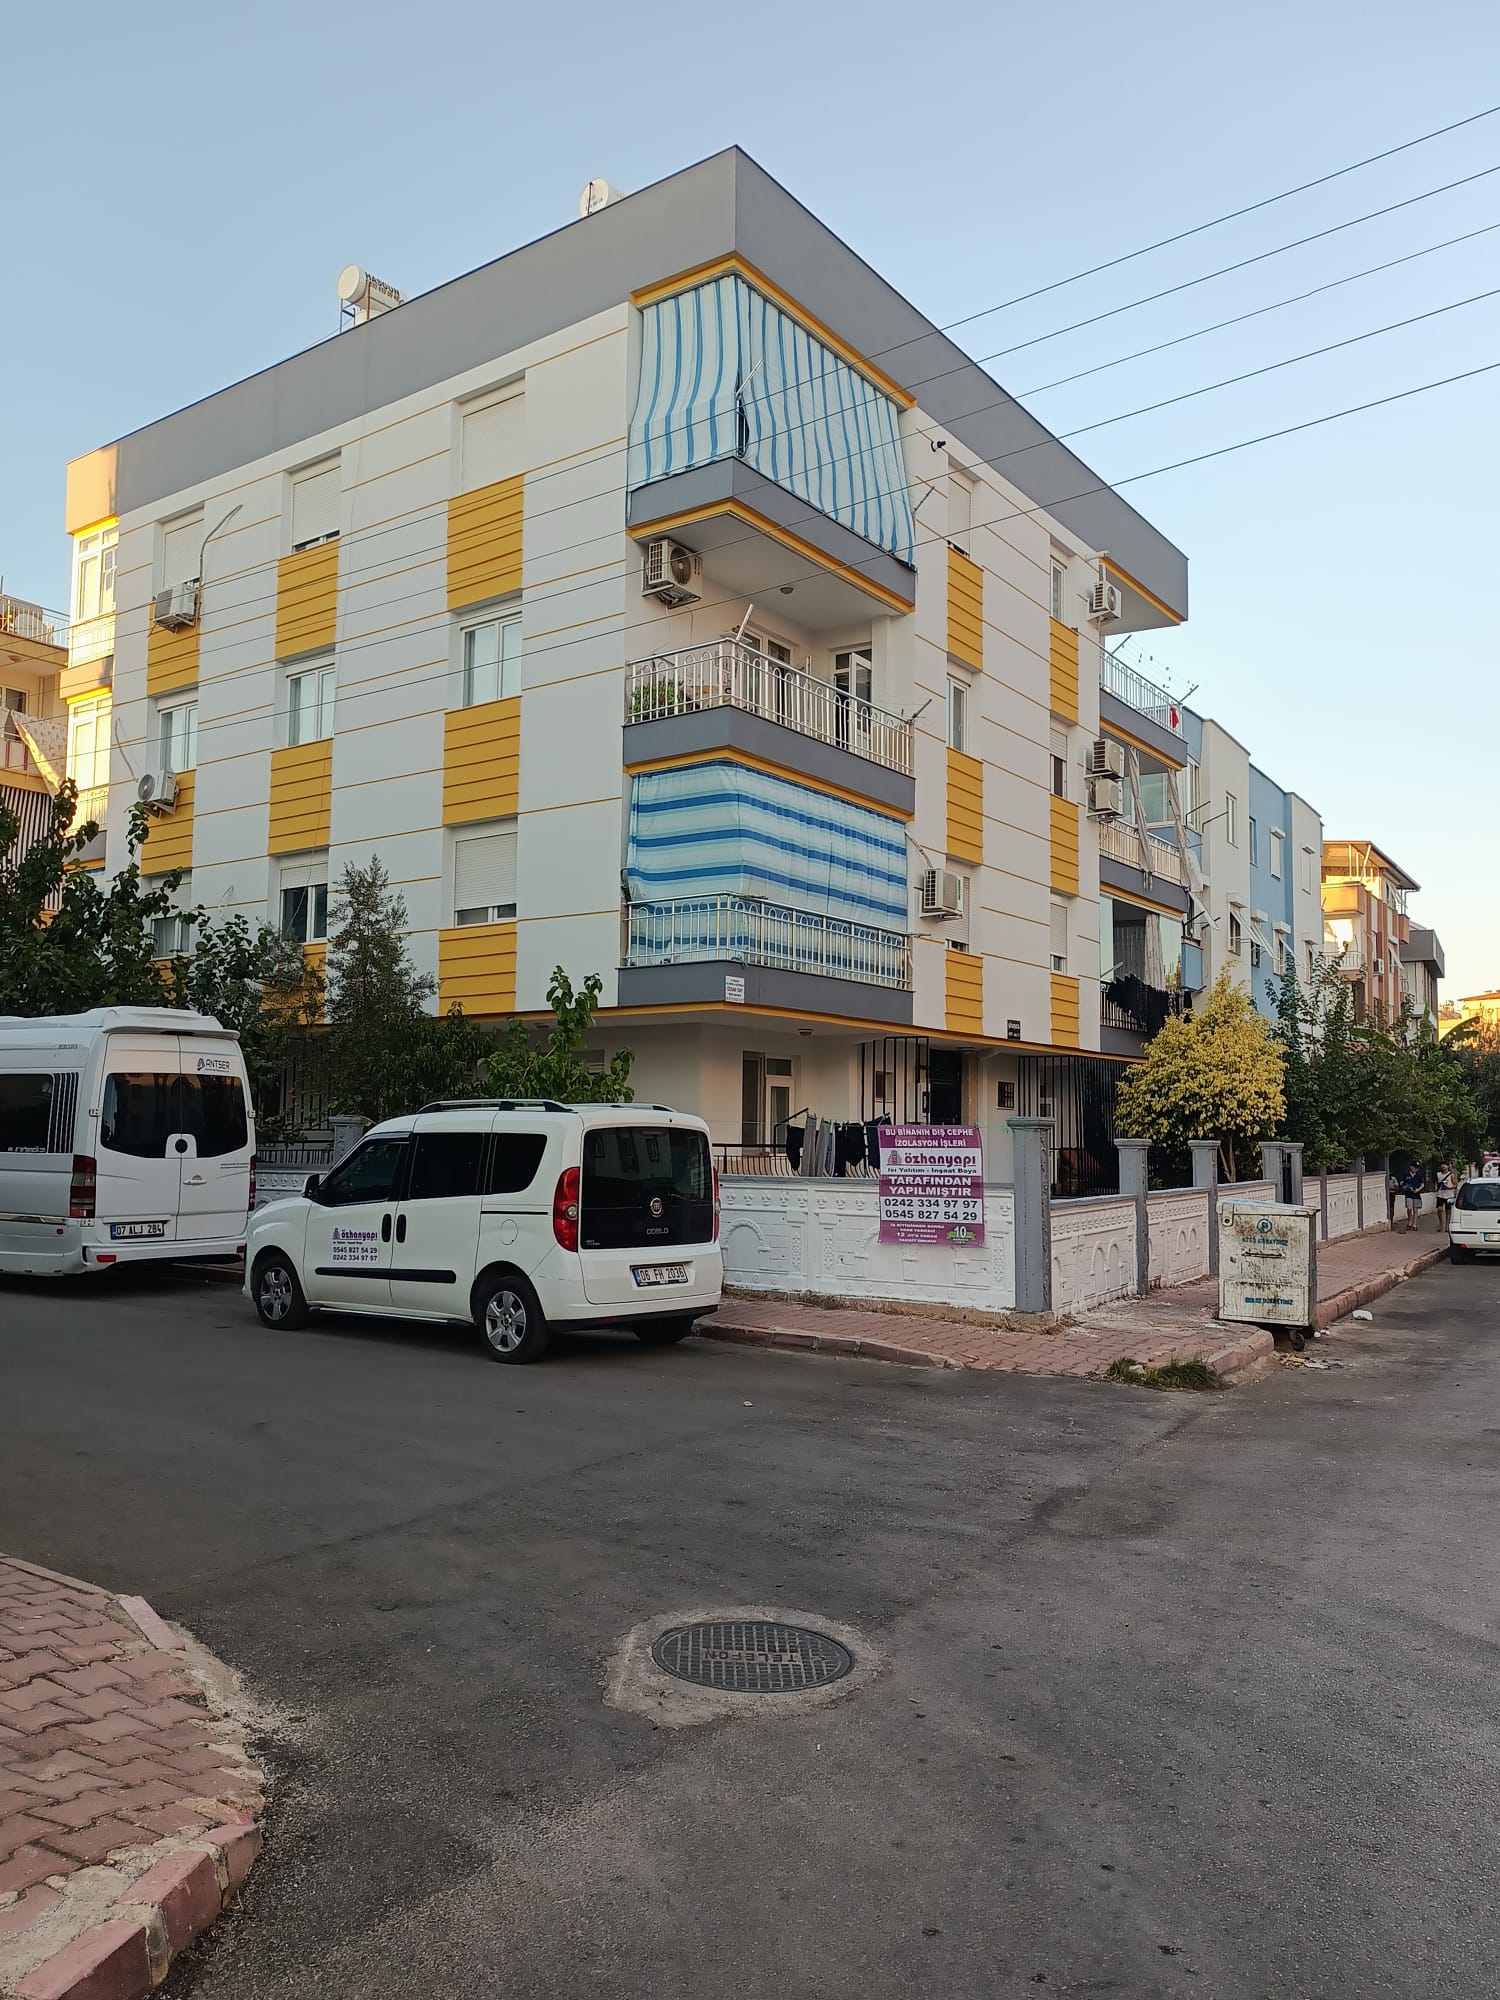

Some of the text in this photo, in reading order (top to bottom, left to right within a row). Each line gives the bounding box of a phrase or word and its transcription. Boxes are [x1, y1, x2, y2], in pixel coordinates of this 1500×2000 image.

[205, 1058, 230, 1070] ANTSER
[885, 1127, 974, 1137] BU BİNANIN DIŞ CEPHE
[894, 1138, 967, 1148] İZOLASYON İŞLERİ
[904, 1152, 976, 1168] özhanyapı
[888, 1176, 972, 1186] TARAFINDAN
[888, 1186, 972, 1198] YAPILMIŞTIR
[884, 1198, 978, 1209] 0242 334 97 97
[885, 1209, 978, 1221] 0545 827 54 29
[116, 1223, 162, 1236] 07 ALJ 284
[341, 1229, 378, 1241] özhanyapı
[646, 1227, 669, 1235] DOBLO
[953, 1226, 967, 1238] 10
[348, 1246, 360, 1254] 827
[370, 1254, 378, 1262] 97
[640, 1267, 685, 1281] 06 FH 2036
[705, 1649, 797, 1663] TELEFON
